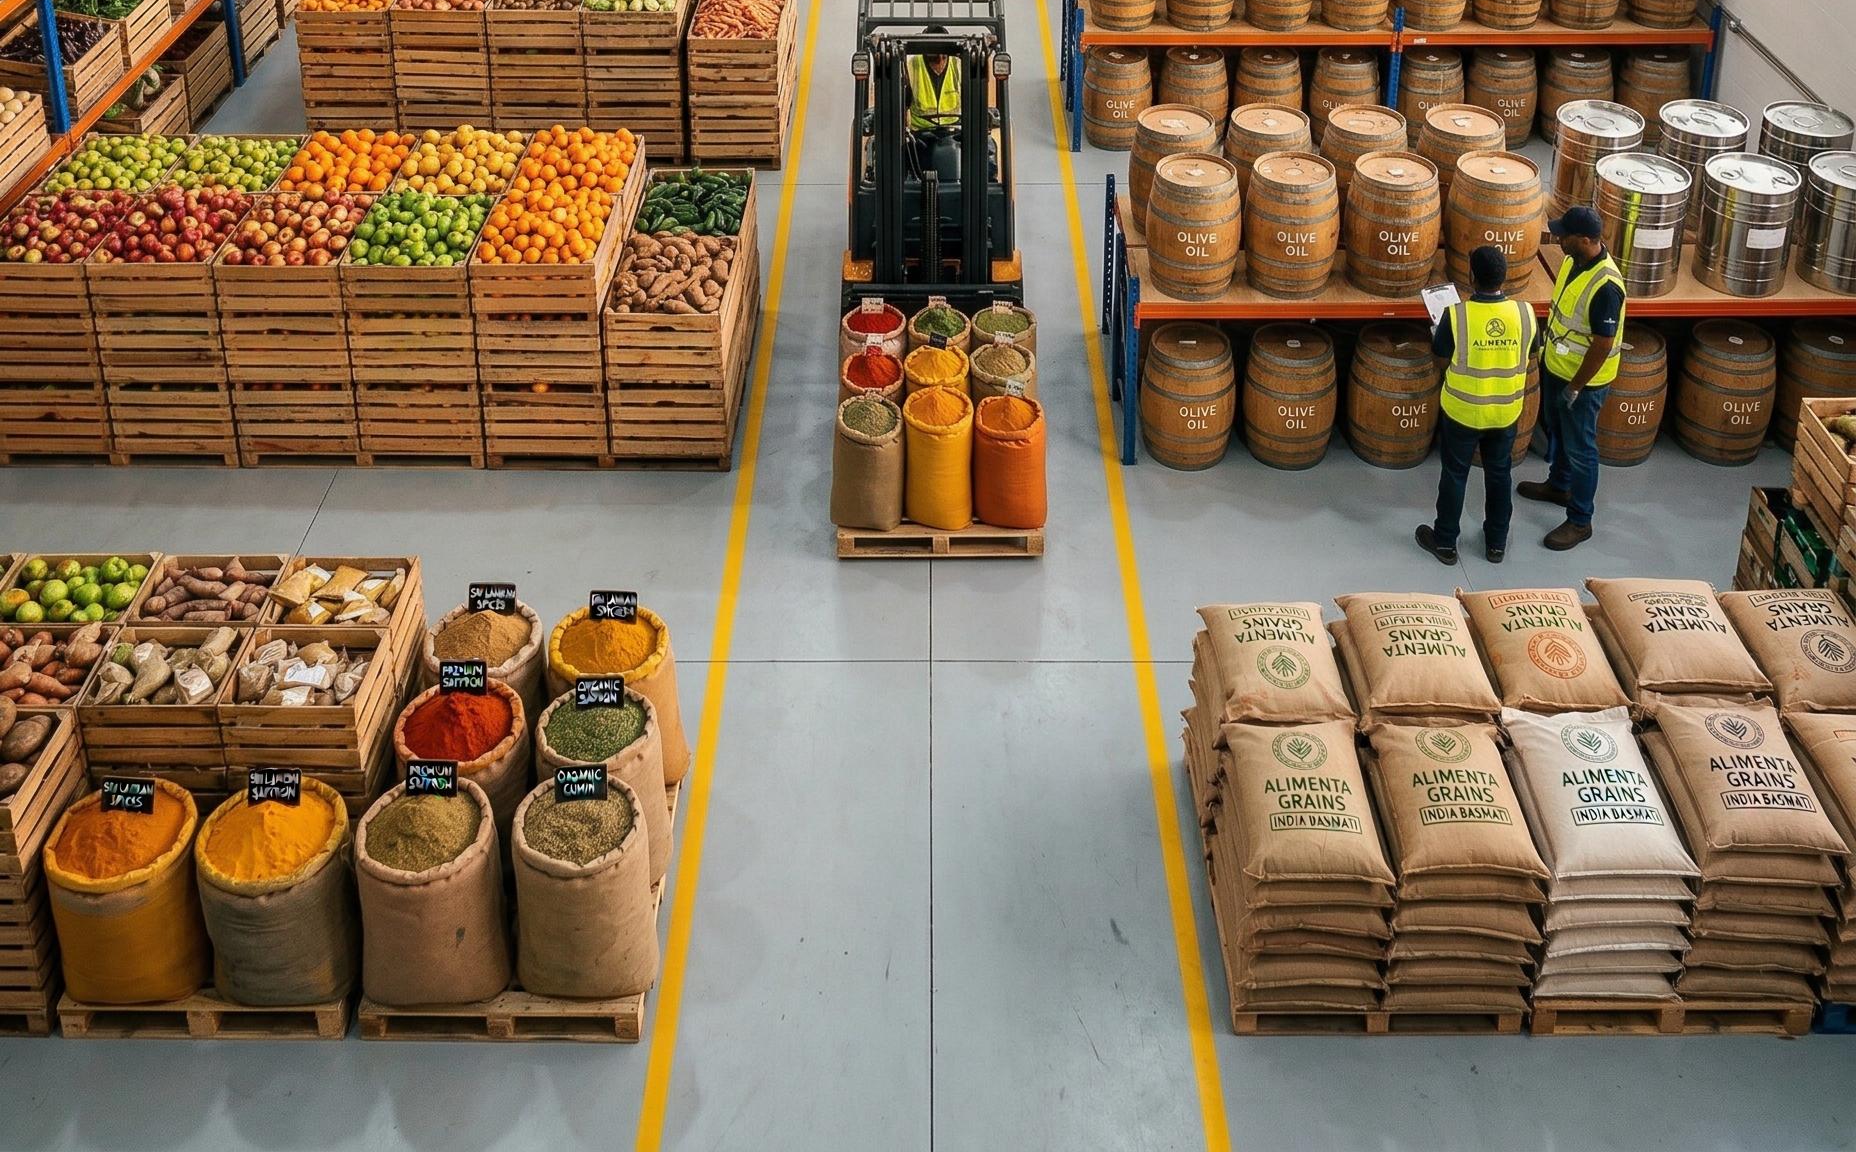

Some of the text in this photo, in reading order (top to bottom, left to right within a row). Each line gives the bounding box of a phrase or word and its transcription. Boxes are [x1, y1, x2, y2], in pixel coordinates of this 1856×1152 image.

[1112, 109, 1129, 119] OIL
[1503, 107, 1521, 117] OIL
[1276, 231, 1317, 244] OLIVE
[1378, 230, 1420, 243] OLIVE
[1484, 229, 1525, 242] OLIVE
[1185, 246, 1210, 257] OIL
[1285, 245, 1309, 257] OIL
[1387, 244, 1411, 256] OIL
[1179, 404, 1217, 418] OLIVE
[1277, 405, 1316, 417] OLIVE
[1391, 403, 1428, 416] OLIVE
[1619, 400, 1655, 413] OLIVE
[1723, 401, 1761, 413] OLIVE
[1187, 419, 1208, 430] OIL
[1285, 419, 1307, 429] OIL
[1400, 418, 1420, 428] OIL
[1627, 414, 1648, 425] OIL
[1730, 415, 1752, 425] OIL
[1242, 617, 1304, 631] GRAINS
[1502, 617, 1583, 633] ALIMENTA
[1642, 617, 1728, 635] ALIMENTA
[1765, 614, 1849, 632] ALIMENTA
[1233, 628, 1316, 645] ALIMENTA
[1388, 629, 1454, 643] GRAINS
[1382, 642, 1467, 659] ALIMENTA
[1710, 754, 1798, 775] ALIMENTA
[1412, 768, 1500, 789] ALIMENTA
[1562, 768, 1649, 788] ALIMENTA
[1726, 771, 1796, 789] GRAINS
[1264, 776, 1353, 795] ALIMENTA
[1427, 785, 1495, 803] GRAINS
[1577, 786, 1646, 804] GRAINS
[1725, 793, 1760, 806] INDIA
[1278, 794, 1346, 811] GRAINS
[1273, 814, 1307, 828] INDIA
[1423, 807, 1458, 822] INDIA
[1575, 809, 1610, 822] INDIA
